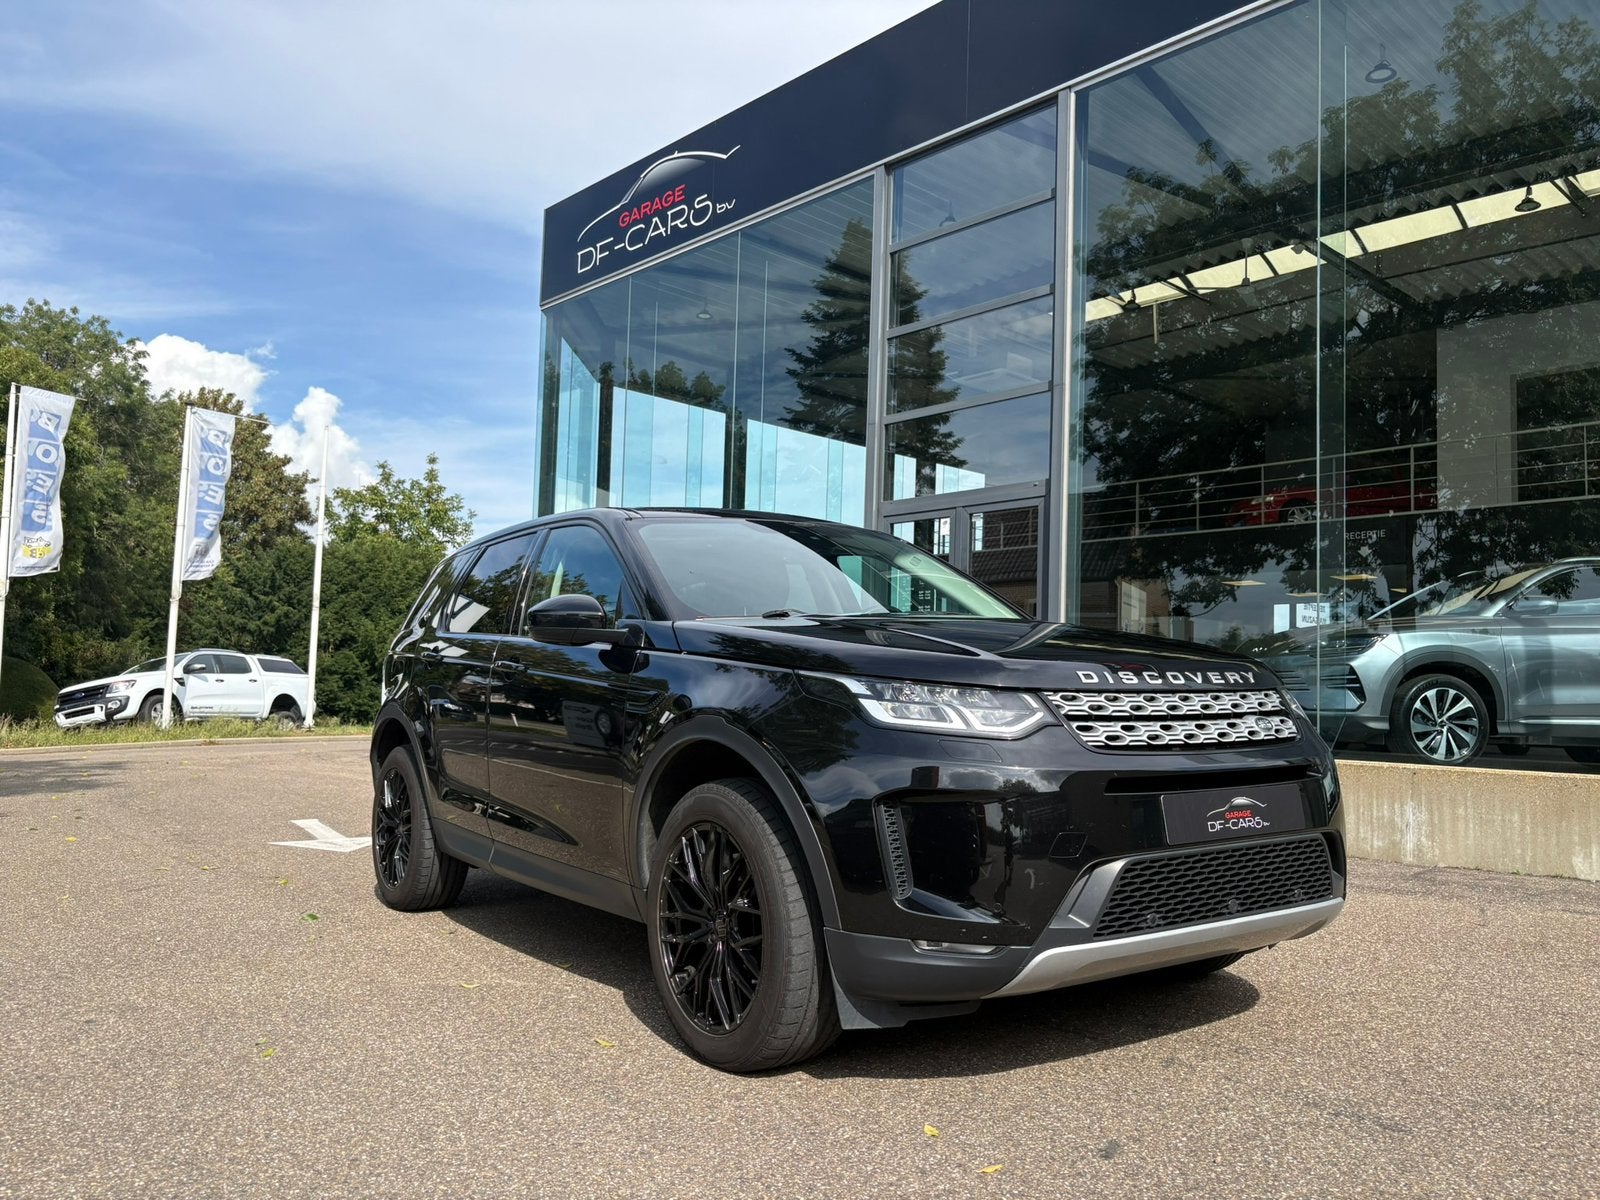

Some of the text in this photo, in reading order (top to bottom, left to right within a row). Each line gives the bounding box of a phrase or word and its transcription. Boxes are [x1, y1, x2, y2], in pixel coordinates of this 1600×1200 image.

[618, 184, 687, 228] GARAGE
[577, 193, 736, 274] DF-CARS bv
[1345, 529, 1387, 540] RECEPTIE
[1076, 670, 1255, 684] DISCOVERY
[1225, 810, 1252, 819] GARAGE
[1207, 816, 1263, 832] DF-CARS
